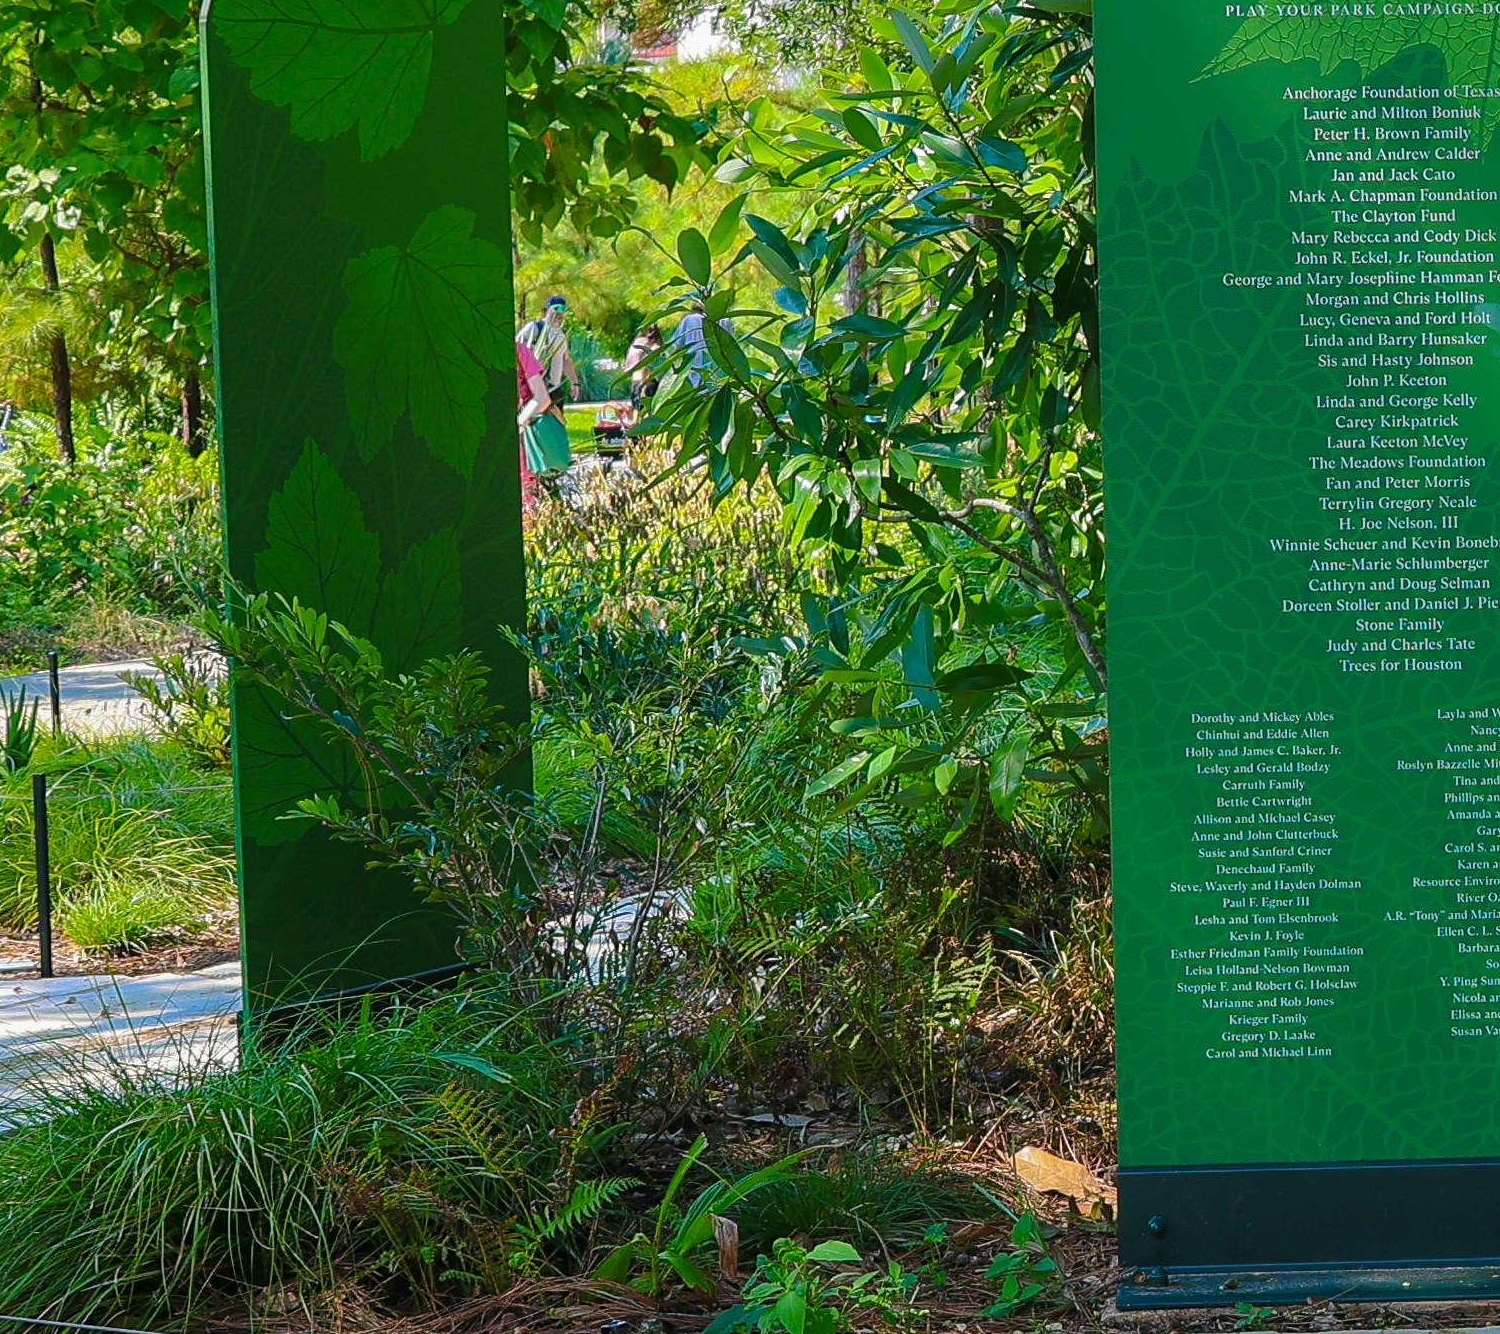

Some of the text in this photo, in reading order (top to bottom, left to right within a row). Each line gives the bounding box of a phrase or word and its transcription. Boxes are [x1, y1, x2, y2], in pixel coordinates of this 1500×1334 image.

[1225, 5, 1269, 17] PLAY
[1276, 4, 1323, 17] YOUR
[1331, 4, 1376, 17] PARK
[1383, 3, 1476, 16] CAMPAIGN
[1282, 86, 1358, 103] Anchorage
[1361, 85, 1440, 98] Foundation
[1443, 84, 1461, 98] of
[1302, 105, 1482, 120] Laurie and Milton Boniuk
[1313, 126, 1472, 142] Peter H. Brown Family
[1304, 147, 1482, 161] Anne and Andrew Calder
[1288, 187, 1498, 205] Mark A. Chapman Foundation
[1330, 208, 1456, 226] The Clayton Fund
[1291, 228, 1497, 247] Mary Rebecca and Cody Dick
[1222, 272, 1272, 288] George
[1276, 272, 1302, 285] and
[1306, 272, 1344, 288] Mary
[1347, 270, 1416, 287] Josephine
[1420, 270, 1484, 284] Hamman
[1306, 291, 1485, 308] Morgan and Chris Hollins
[1299, 311, 1492, 329] Lucy, Geneva and Ford Holt
[1304, 331, 1488, 348] Linda and Barry Hunsaker
[1345, 373, 1448, 387] John P. Keeton
[1334, 414, 1459, 431] Carey Kirkpatrick
[1326, 434, 1468, 450] Laura Keeton McVey
[1308, 454, 1486, 469] The Meadows Foundation
[1318, 495, 1477, 513] Terrylin Gregory Neale
[1308, 556, 1490, 572] Anne-Marie Schlumberger
[1308, 576, 1490, 594] Cathryn and Doug Selman
[1355, 617, 1444, 633] Stone Family
[1325, 637, 1476, 655] Judy and Charles Tate
[1338, 658, 1462, 672] Trees for Houston
[1190, 711, 1334, 725] Dorothy and Mickey Ables
[1444, 742, 1474, 752] Anne
[1476, 741, 1497, 751] and
[1222, 778, 1306, 792] Carruth Family
[1452, 775, 1478, 786] Tina
[1480, 775, 1500, 785] and
[1444, 792, 1484, 805] Phillips
[1192, 811, 1336, 824] Allison and Michael Casey
[1190, 828, 1339, 841] Anne and John Clutterbuck
[1278, 862, 1316, 874] Family
[1412, 876, 1462, 887] Resource
[1222, 897, 1246, 908] Paul
[1261, 896, 1294, 909] Egner
[1296, 896, 1310, 906] III
[1456, 892, 1486, 902] River
[1229, 930, 1262, 941] Kevin
[1275, 930, 1304, 942] Foyle
[1216, 963, 1300, 975] Holland-Nelson
[1302, 962, 1350, 973] Bowman
[1452, 992, 1486, 1003] Nicola
[1228, 1013, 1308, 1027] Krieger Family
[1220, 1031, 1266, 1043] Gregory
[1283, 1029, 1316, 1040] Laake
[1450, 1026, 1482, 1036] Susan
[1205, 1046, 1332, 1058] Carol and Michael Linn
